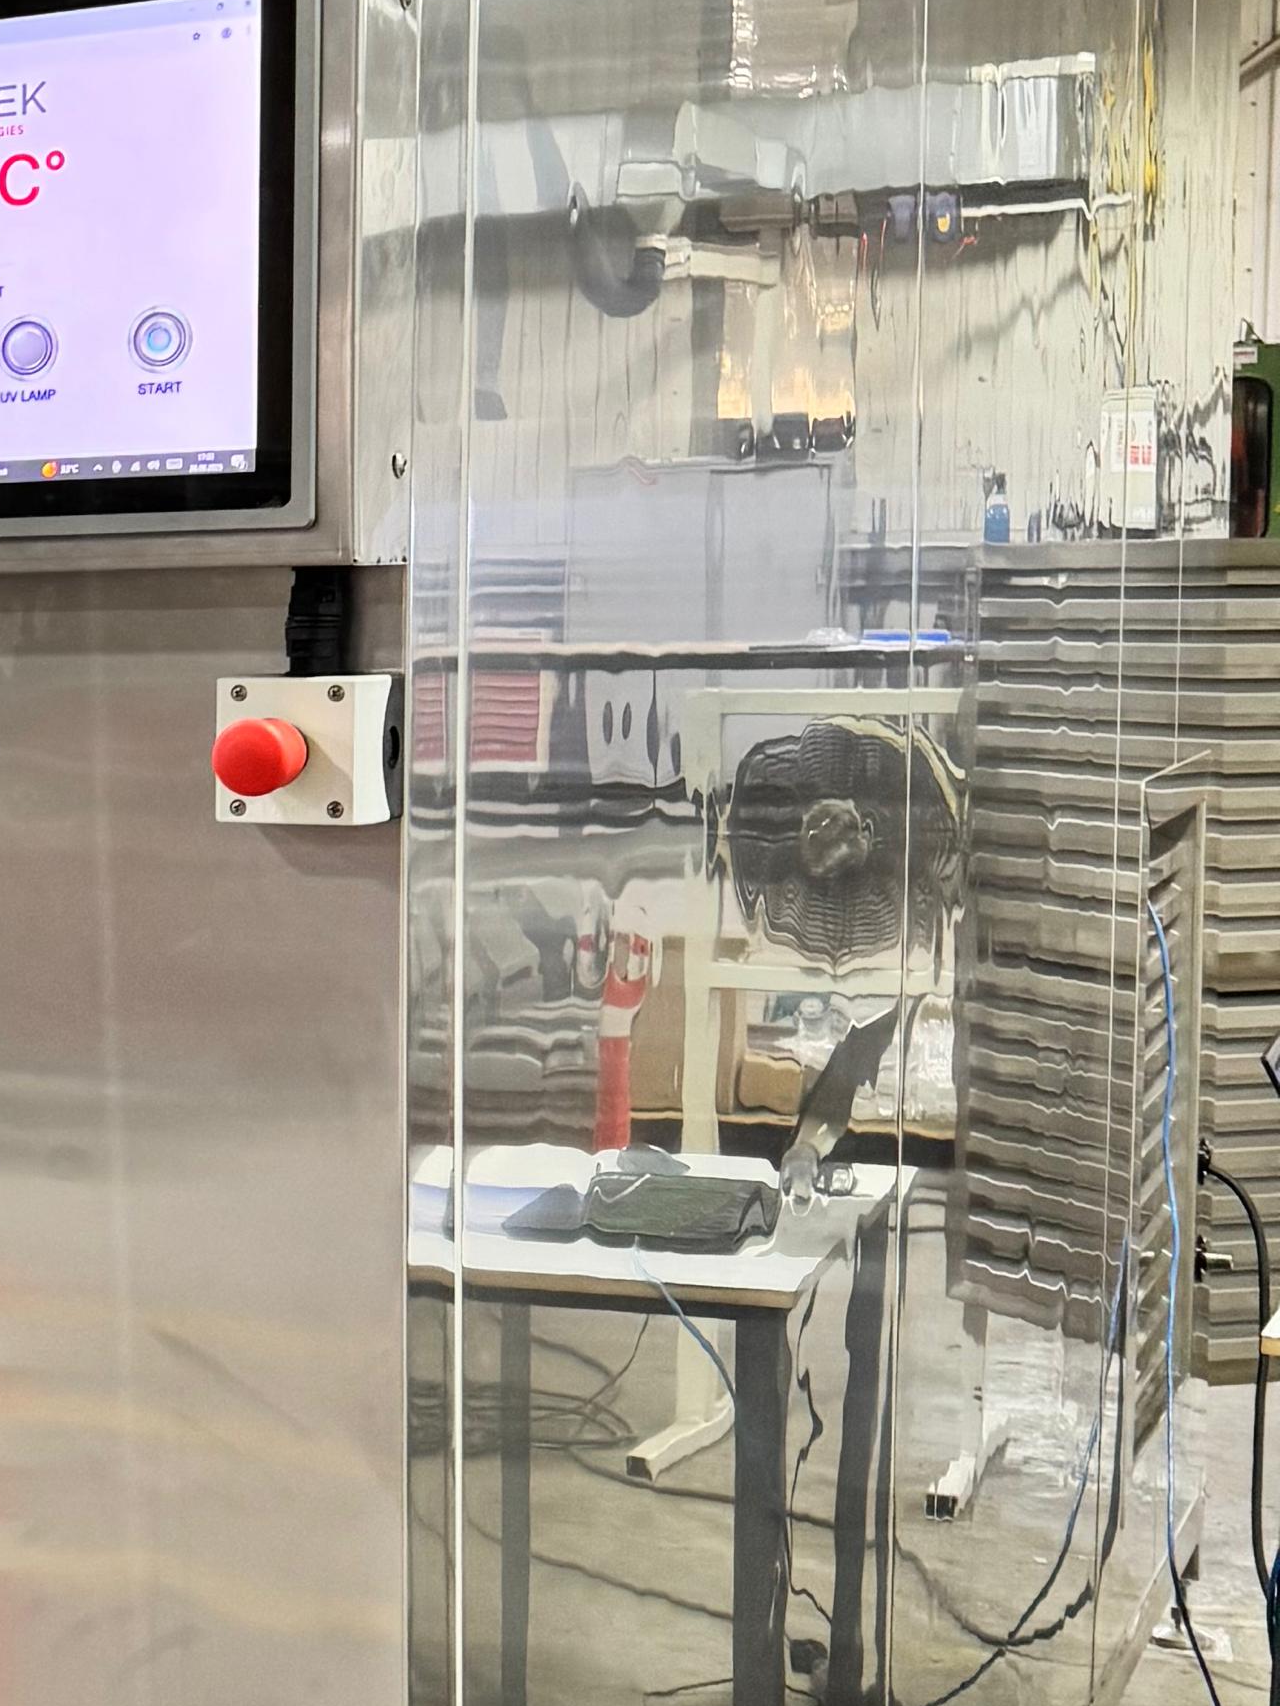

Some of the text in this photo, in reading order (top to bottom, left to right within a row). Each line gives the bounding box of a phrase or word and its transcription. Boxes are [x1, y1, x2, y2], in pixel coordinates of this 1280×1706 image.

[138, 381, 182, 395] START
[0, 389, 56, 404] UV LAMP
